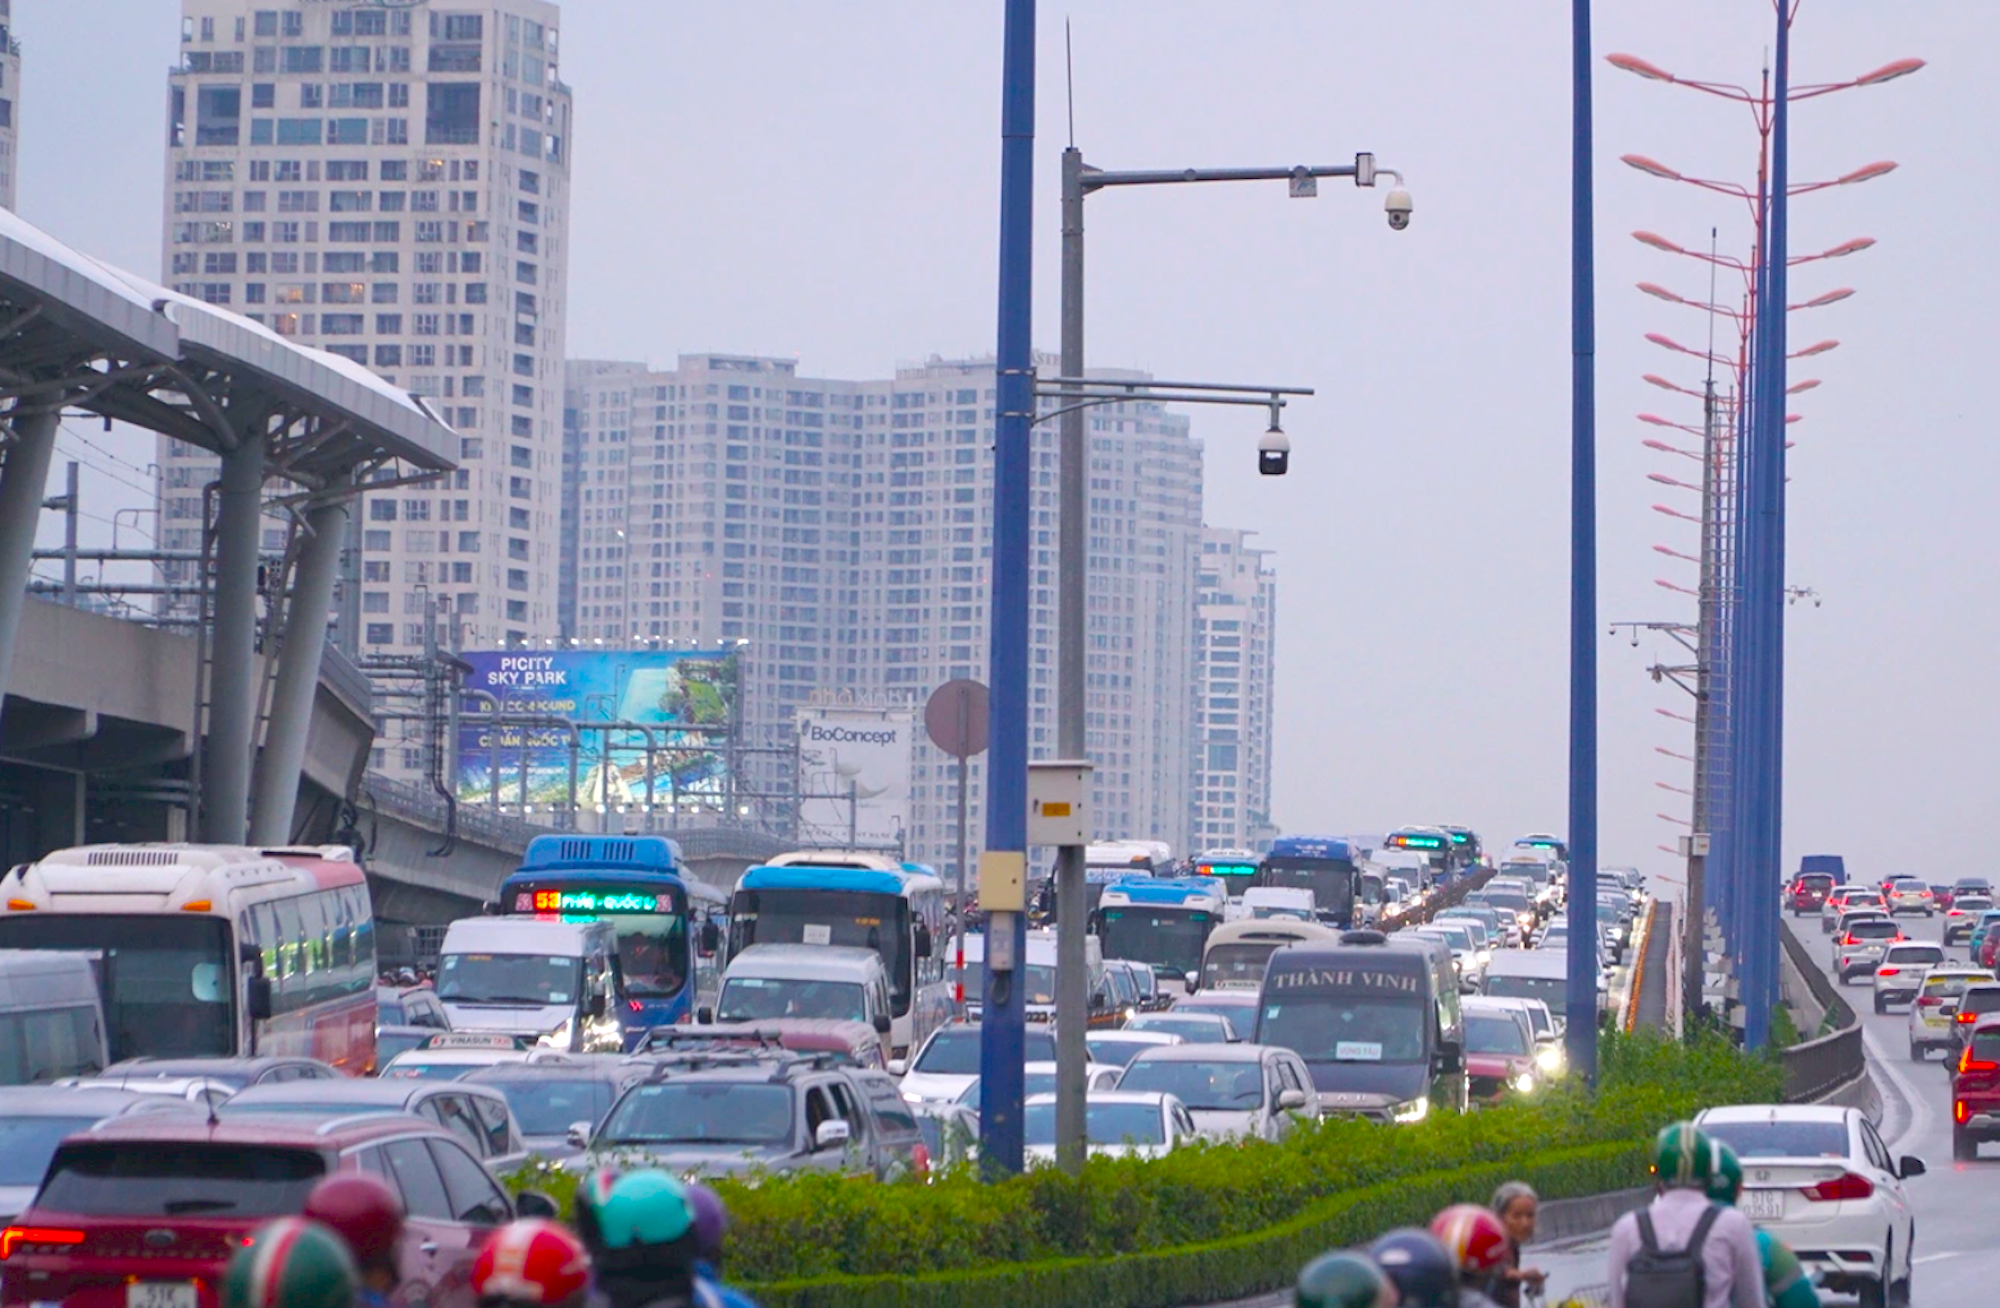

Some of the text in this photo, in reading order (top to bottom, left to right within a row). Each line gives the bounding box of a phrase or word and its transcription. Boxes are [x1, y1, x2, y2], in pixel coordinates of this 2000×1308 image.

[501, 657, 553, 670] PICITY
[488, 671, 567, 685] SKY PARK
[811, 726, 897, 747] BoConcept
[536, 892, 560, 909] 53
[1273, 968, 1353, 989] THÀNH
[1362, 971, 1418, 992] VINH
[449, 1035, 492, 1045] VINASUN
